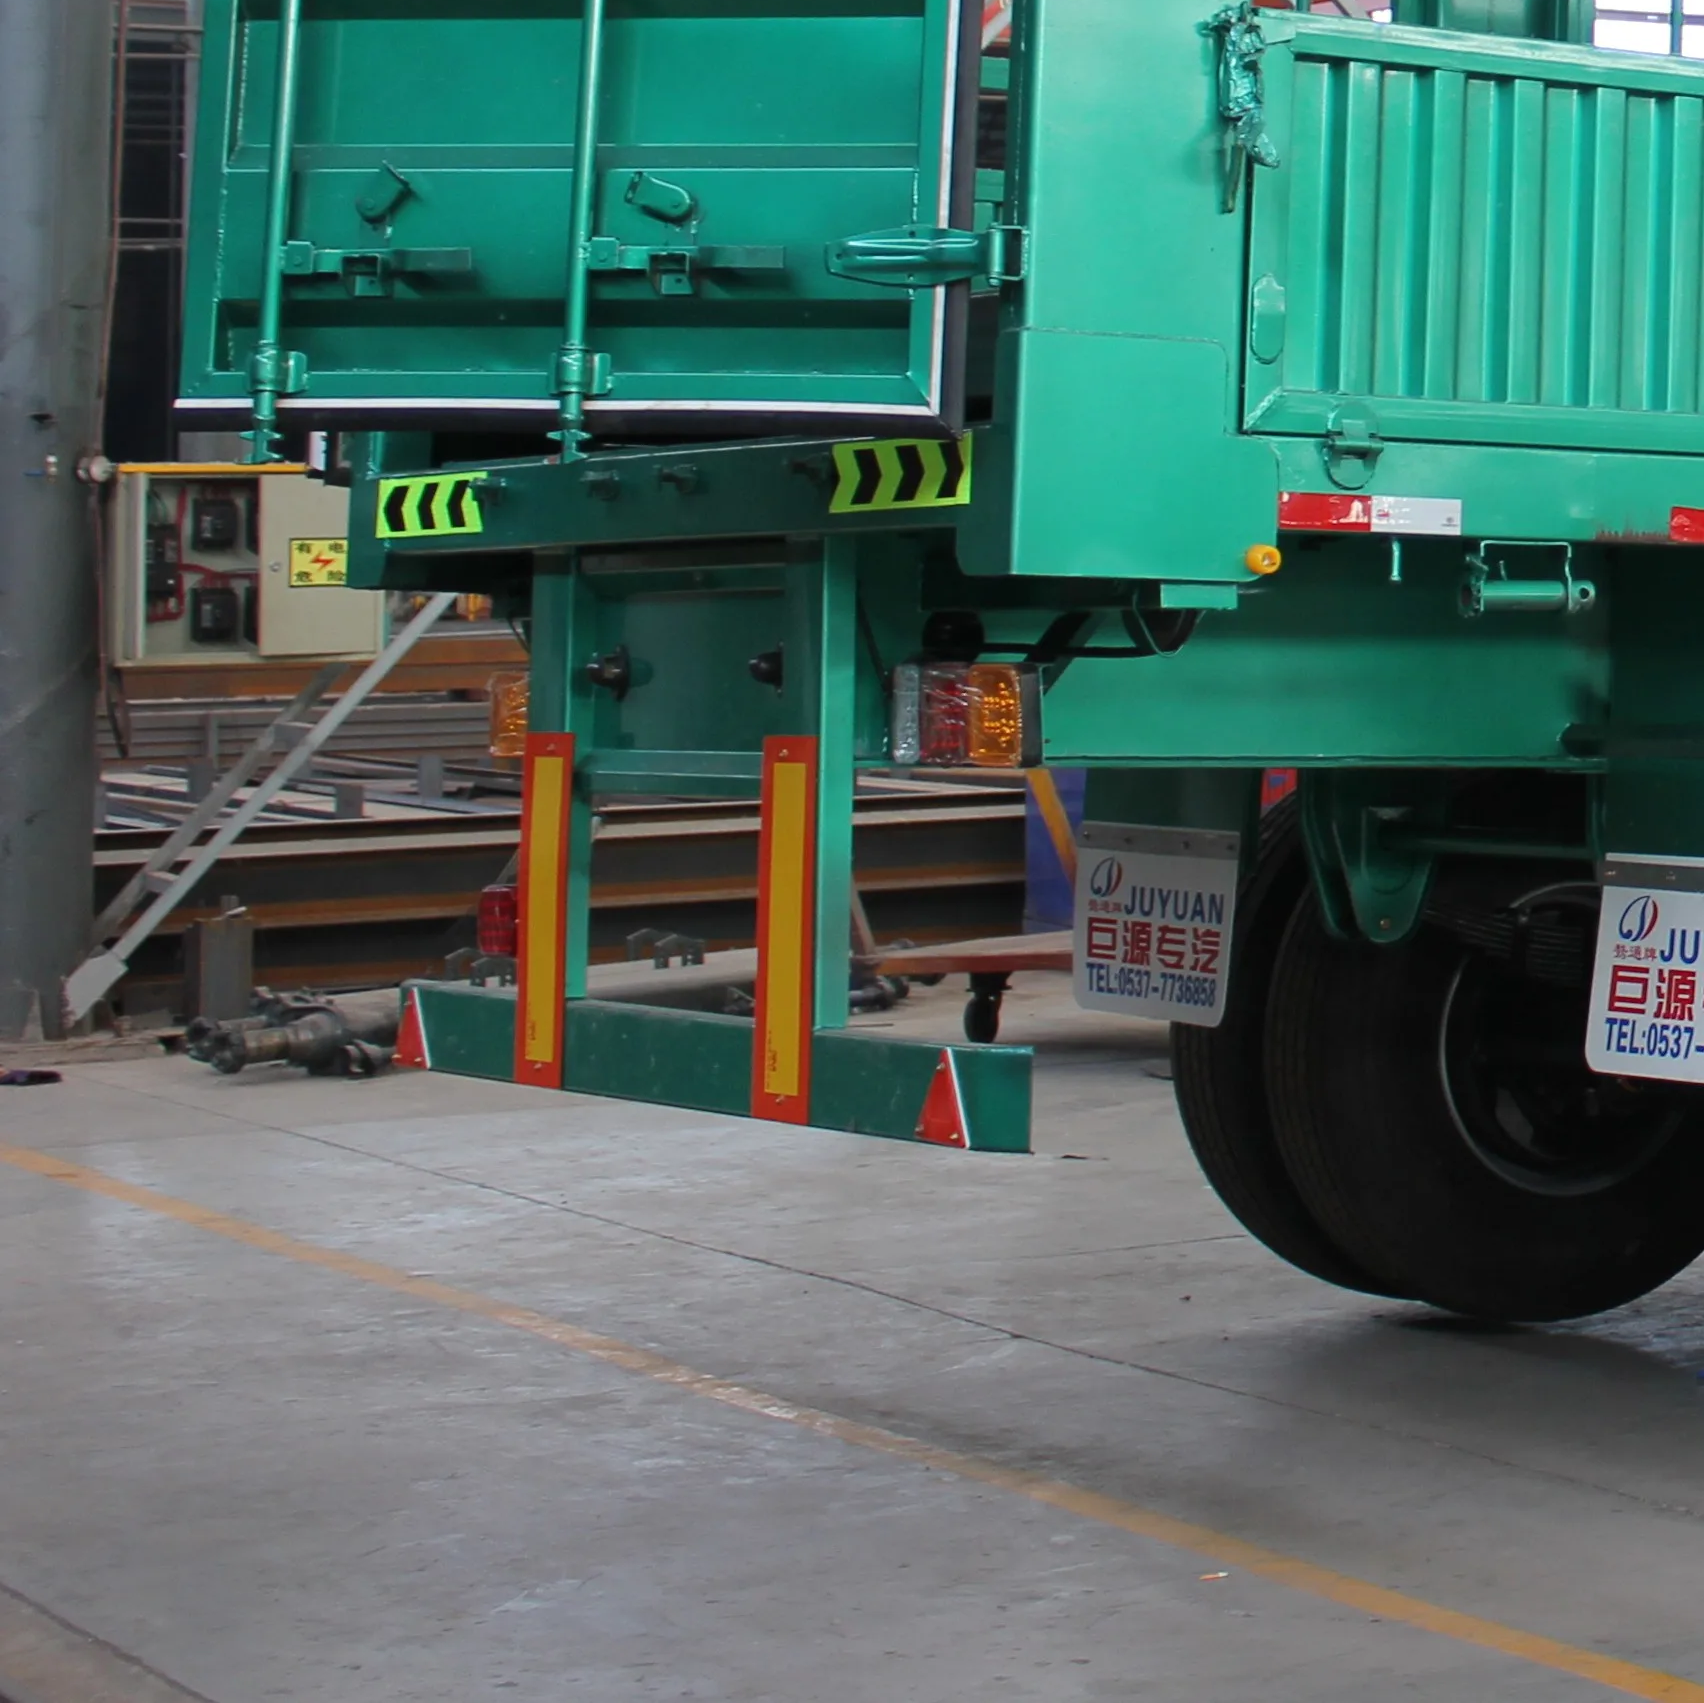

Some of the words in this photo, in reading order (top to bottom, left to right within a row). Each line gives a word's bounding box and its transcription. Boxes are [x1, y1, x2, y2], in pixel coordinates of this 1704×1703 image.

[1124, 885, 1225, 925] JUYUAN
[1086, 916, 1221, 975] 巨源专汽
